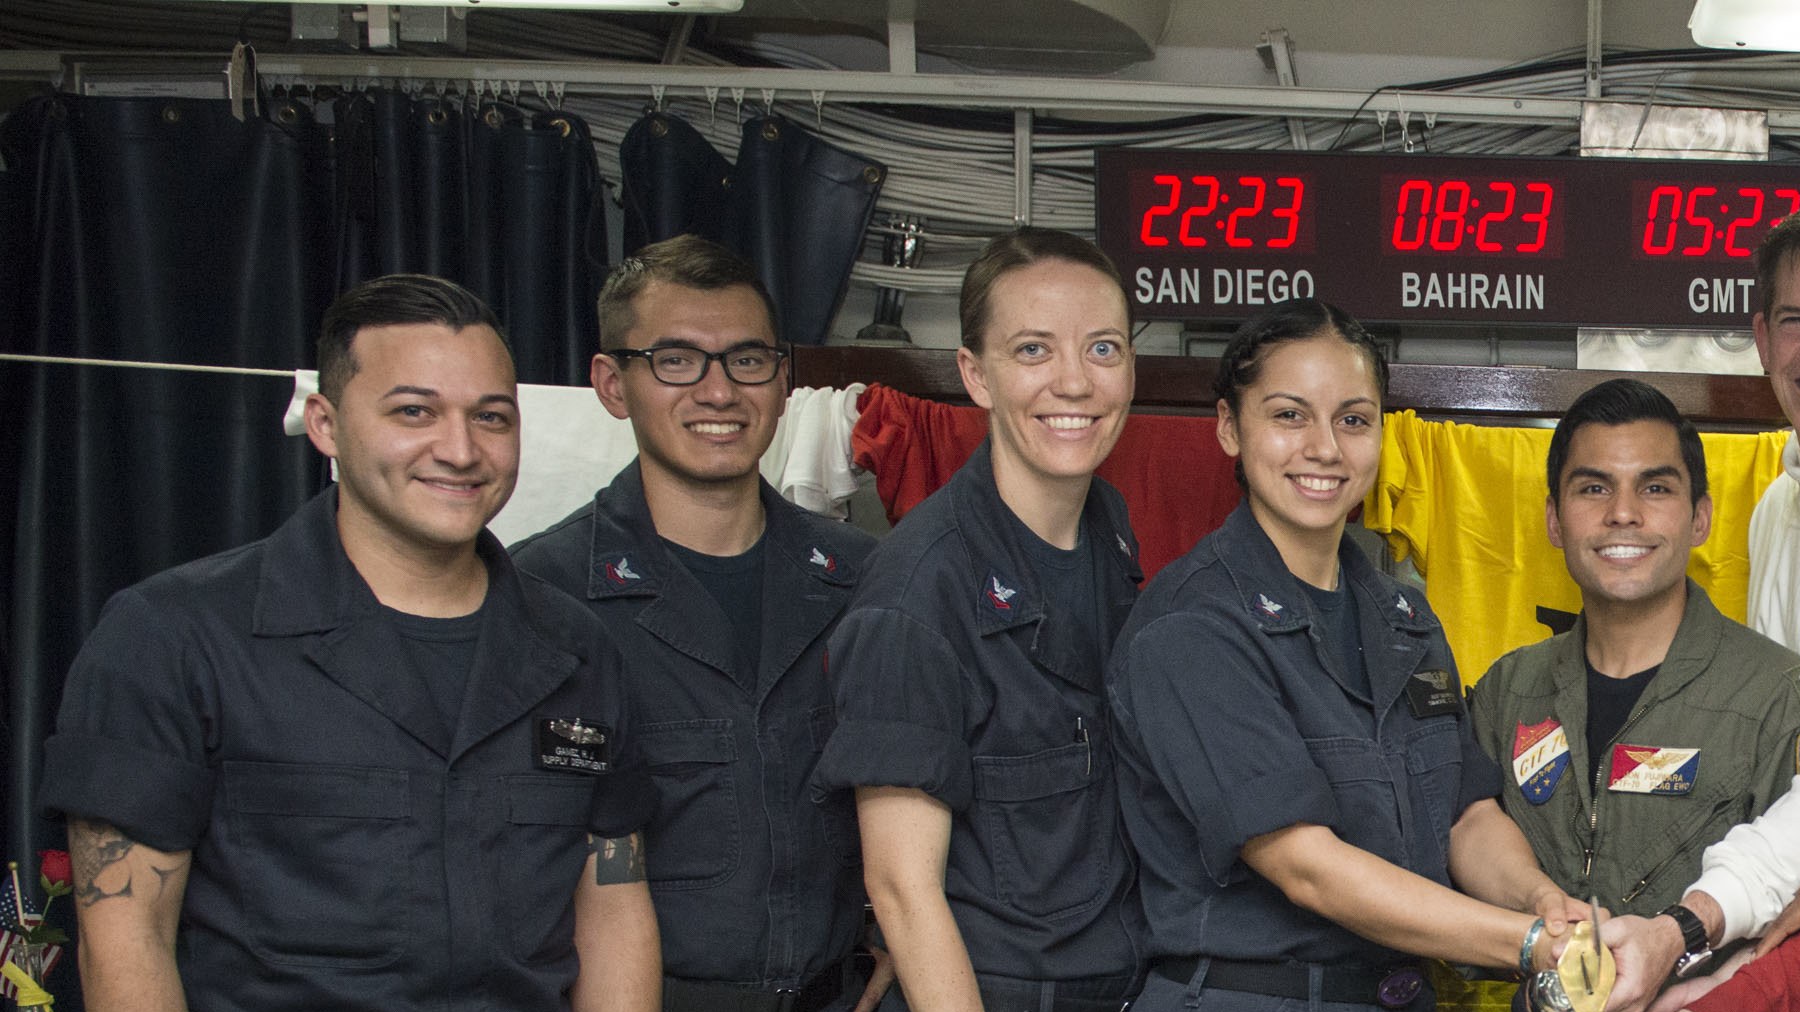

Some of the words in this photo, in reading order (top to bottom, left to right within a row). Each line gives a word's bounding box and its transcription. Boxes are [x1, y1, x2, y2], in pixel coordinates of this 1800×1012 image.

[1141, 175, 1304, 248] 22:23
[1393, 180, 1553, 252] 08:23
[1135, 267, 1200, 304] SAN
[1213, 269, 1315, 305] DIEGO
[1402, 272, 1544, 310] BAHRAIN
[1688, 277, 1756, 314] GMT
